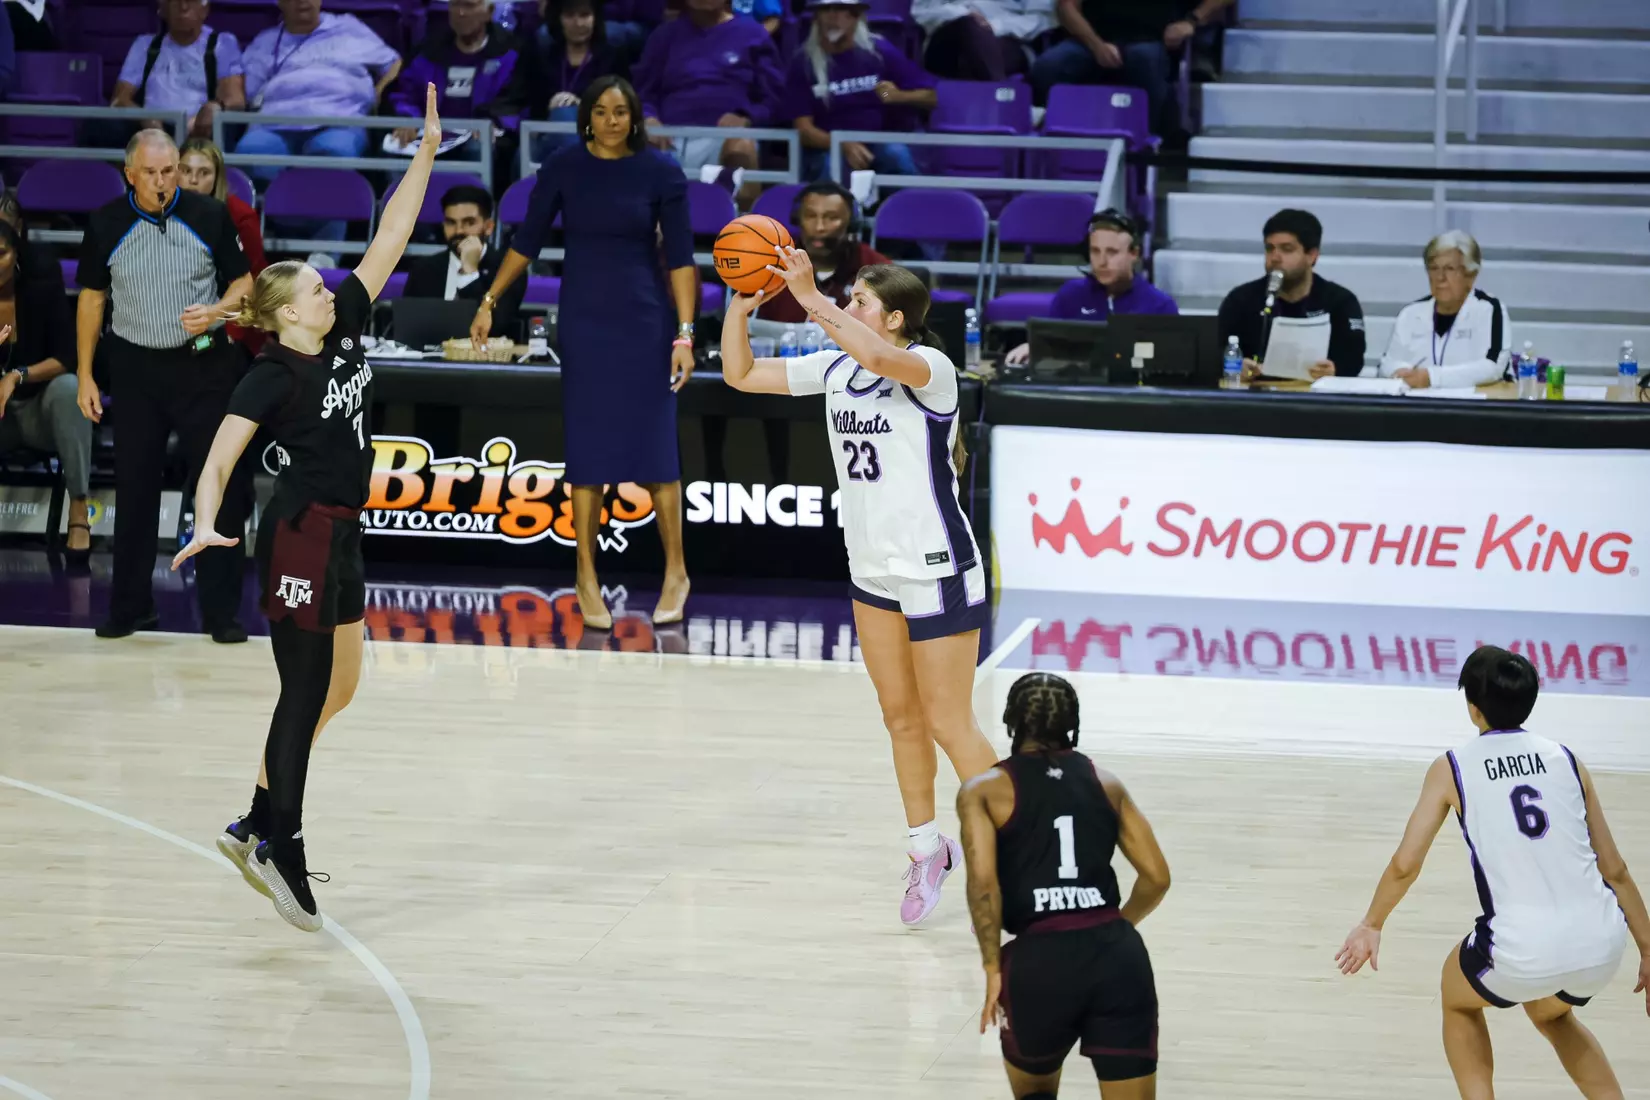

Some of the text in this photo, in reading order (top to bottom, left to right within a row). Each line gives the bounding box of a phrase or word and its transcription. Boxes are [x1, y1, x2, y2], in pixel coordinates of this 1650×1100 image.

[353, 411, 365, 450] 7
[831, 408, 892, 435] Wildcats
[843, 440, 882, 482] 23
[360, 509, 496, 532] AUTO.COM
[686, 480, 824, 527] SINCE
[1147, 502, 1466, 568] SMOOTHIE
[1484, 752, 1547, 781] GARCIA
[1509, 784, 1550, 840] 6
[1053, 815, 1078, 879] 1
[1033, 886, 1106, 912] PRYOR
